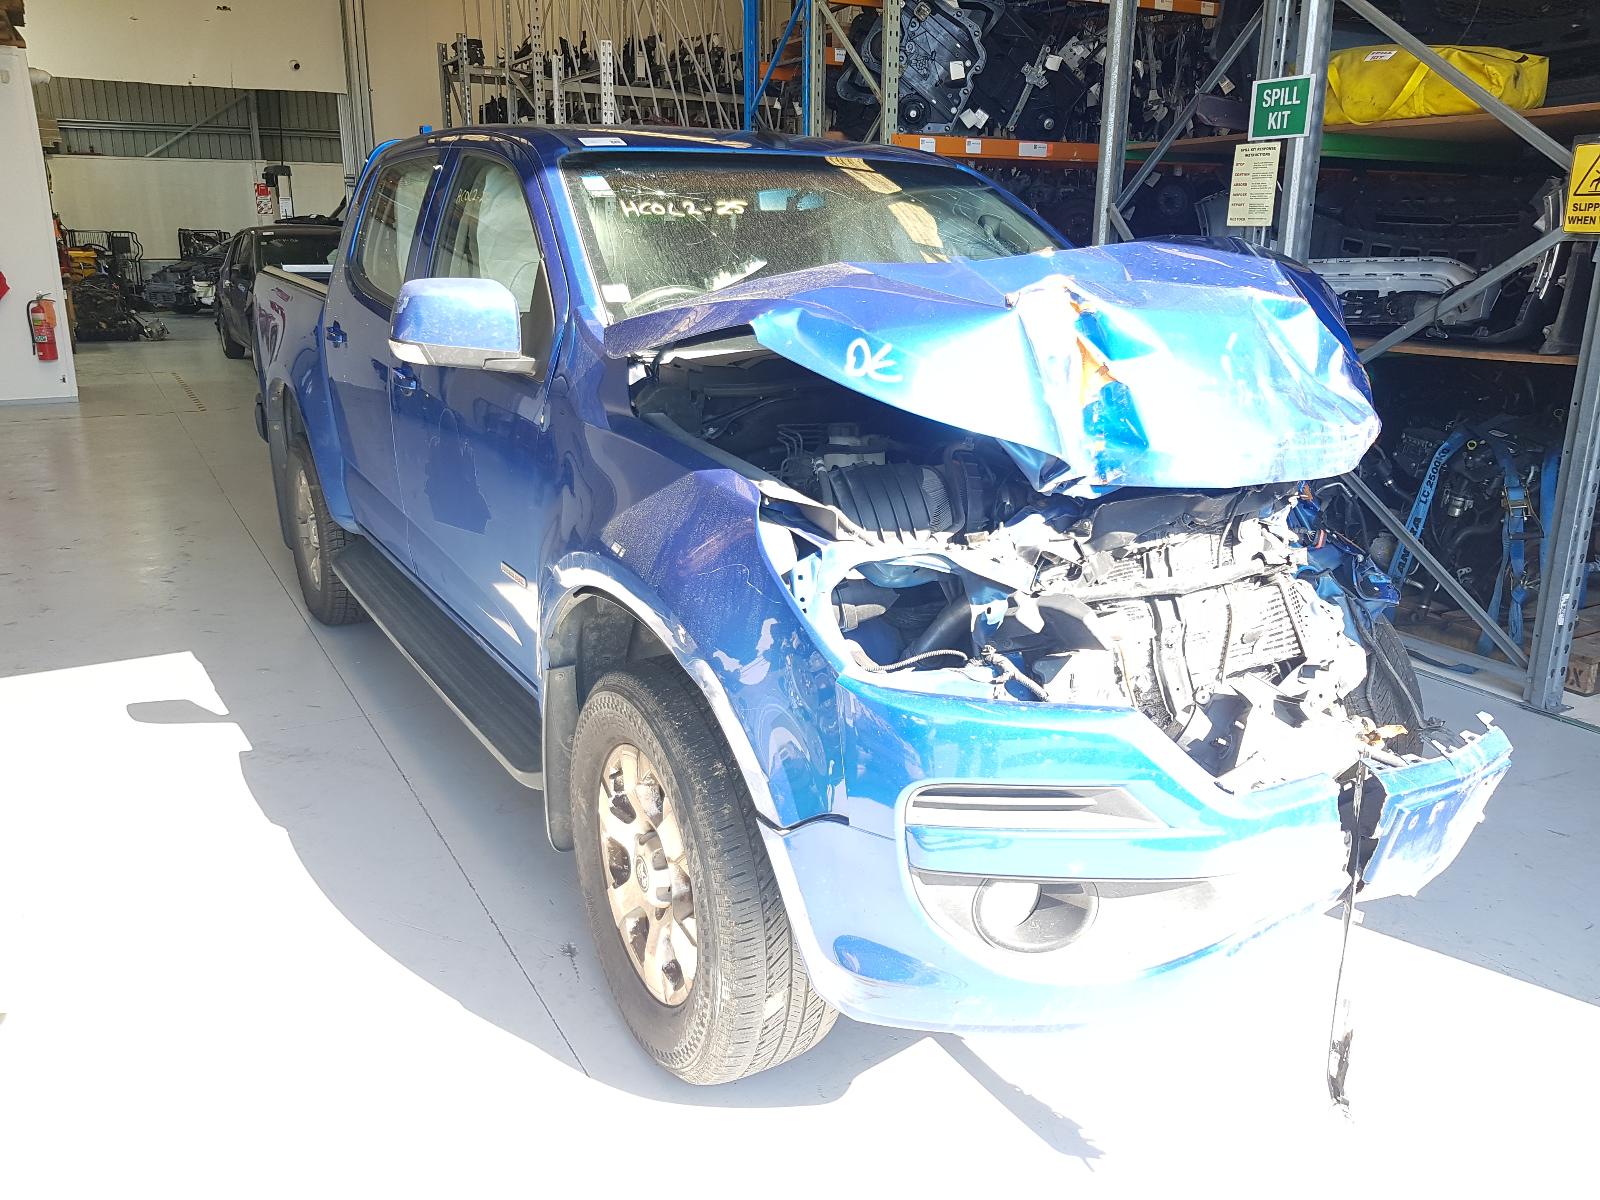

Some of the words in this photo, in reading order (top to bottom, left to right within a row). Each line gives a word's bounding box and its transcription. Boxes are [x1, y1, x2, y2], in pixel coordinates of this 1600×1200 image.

[1262, 86, 1301, 108] SPILL
[1267, 110, 1291, 130] KIT
[1572, 202, 1600, 212] SLIPP
[1567, 215, 1597, 225] WHEN
[1420, 490, 1431, 505] LC
